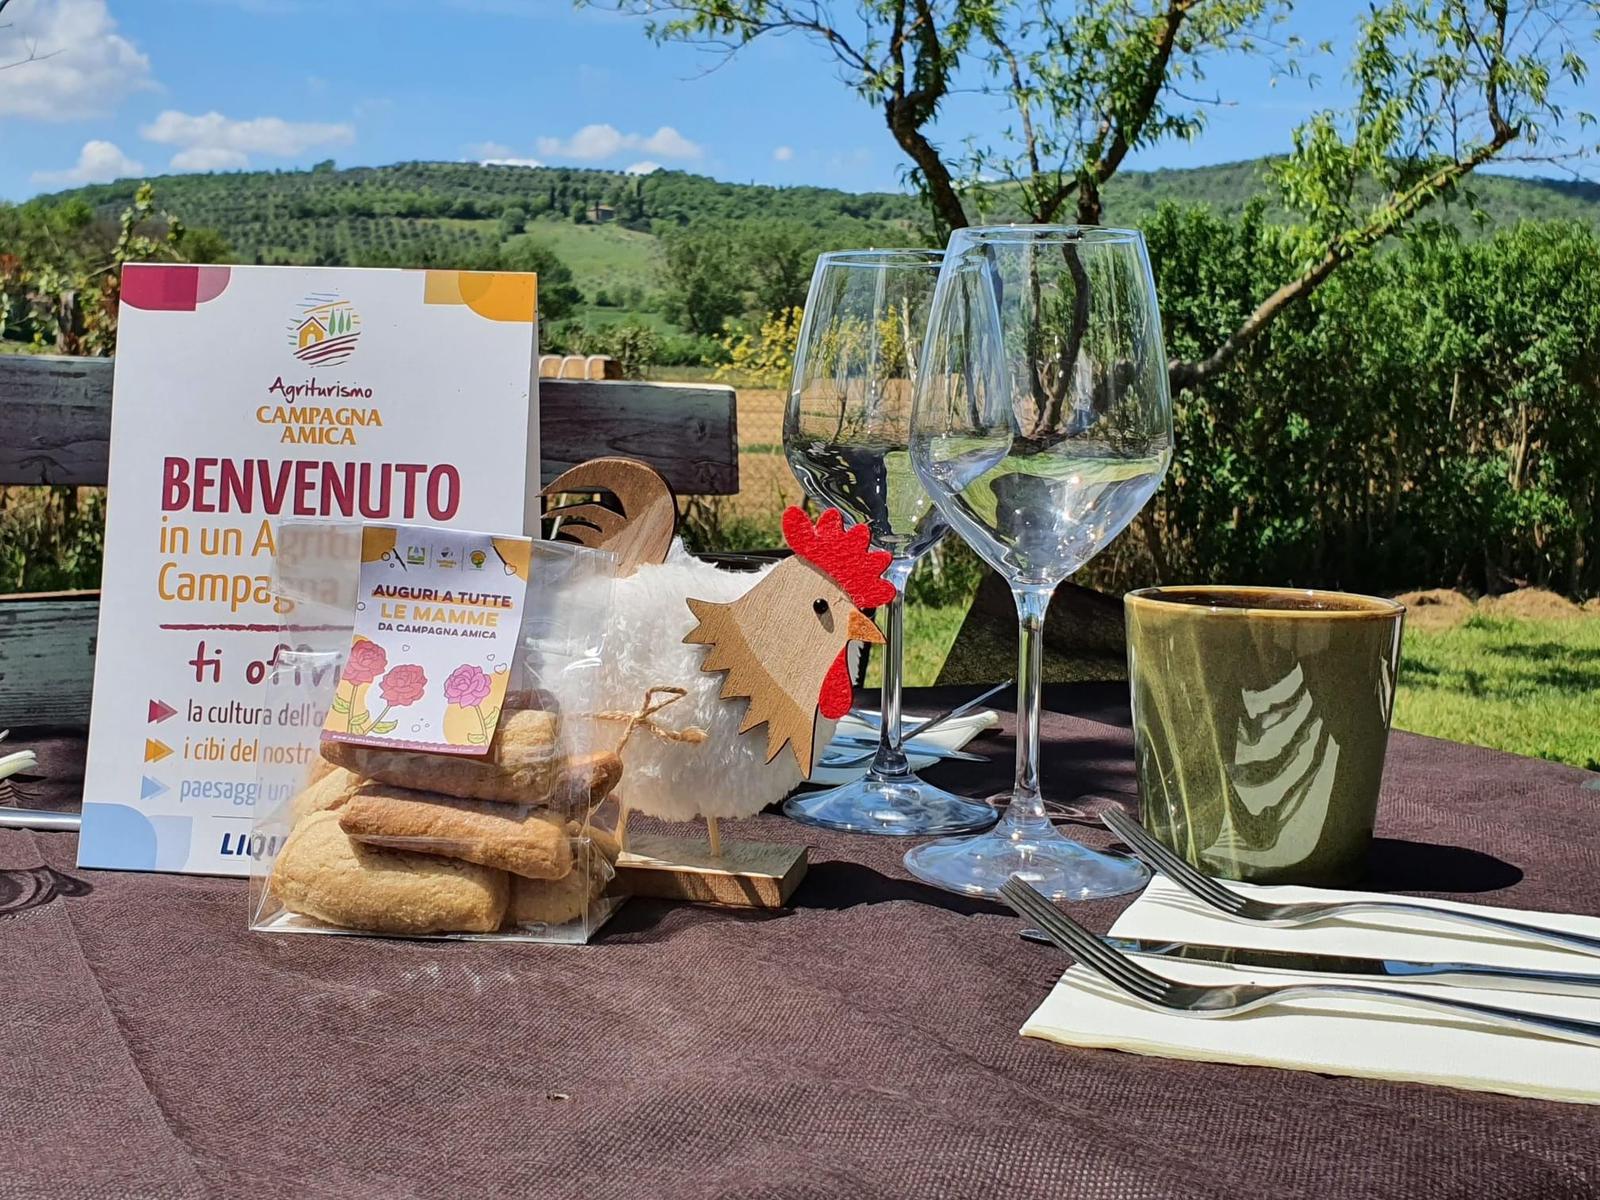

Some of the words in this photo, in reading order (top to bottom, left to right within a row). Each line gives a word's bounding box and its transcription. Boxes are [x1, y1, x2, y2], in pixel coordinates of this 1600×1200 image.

[268, 376, 374, 404] Agriturismo
[256, 405, 383, 427] CAMPAGNA
[280, 426, 357, 446] AMICA
[162, 456, 461, 521] BENVENUTO
[160, 515, 189, 554] in
[200, 528, 242, 556] un
[372, 584, 439, 602] AUGURI
[441, 590, 454, 601] A
[458, 591, 513, 608] TUTTE
[380, 603, 408, 619] LE
[412, 605, 499, 628] MAMME
[378, 622, 394, 633] DA
[396, 623, 459, 637] CAMPAGNA
[461, 627, 497, 640] AMICA
[188, 640, 223, 684] ti
[187, 699, 203, 724] la
[208, 700, 272, 725] cultura
[278, 703, 327, 728] dell'o
[183, 737, 190, 760] i
[194, 737, 225, 761] cibi
[230, 738, 259, 763] del
[263, 743, 314, 765] nostr
[180, 777, 264, 806] paesaggi
[268, 778, 296, 801] uni
[220, 832, 288, 860] LIQU
